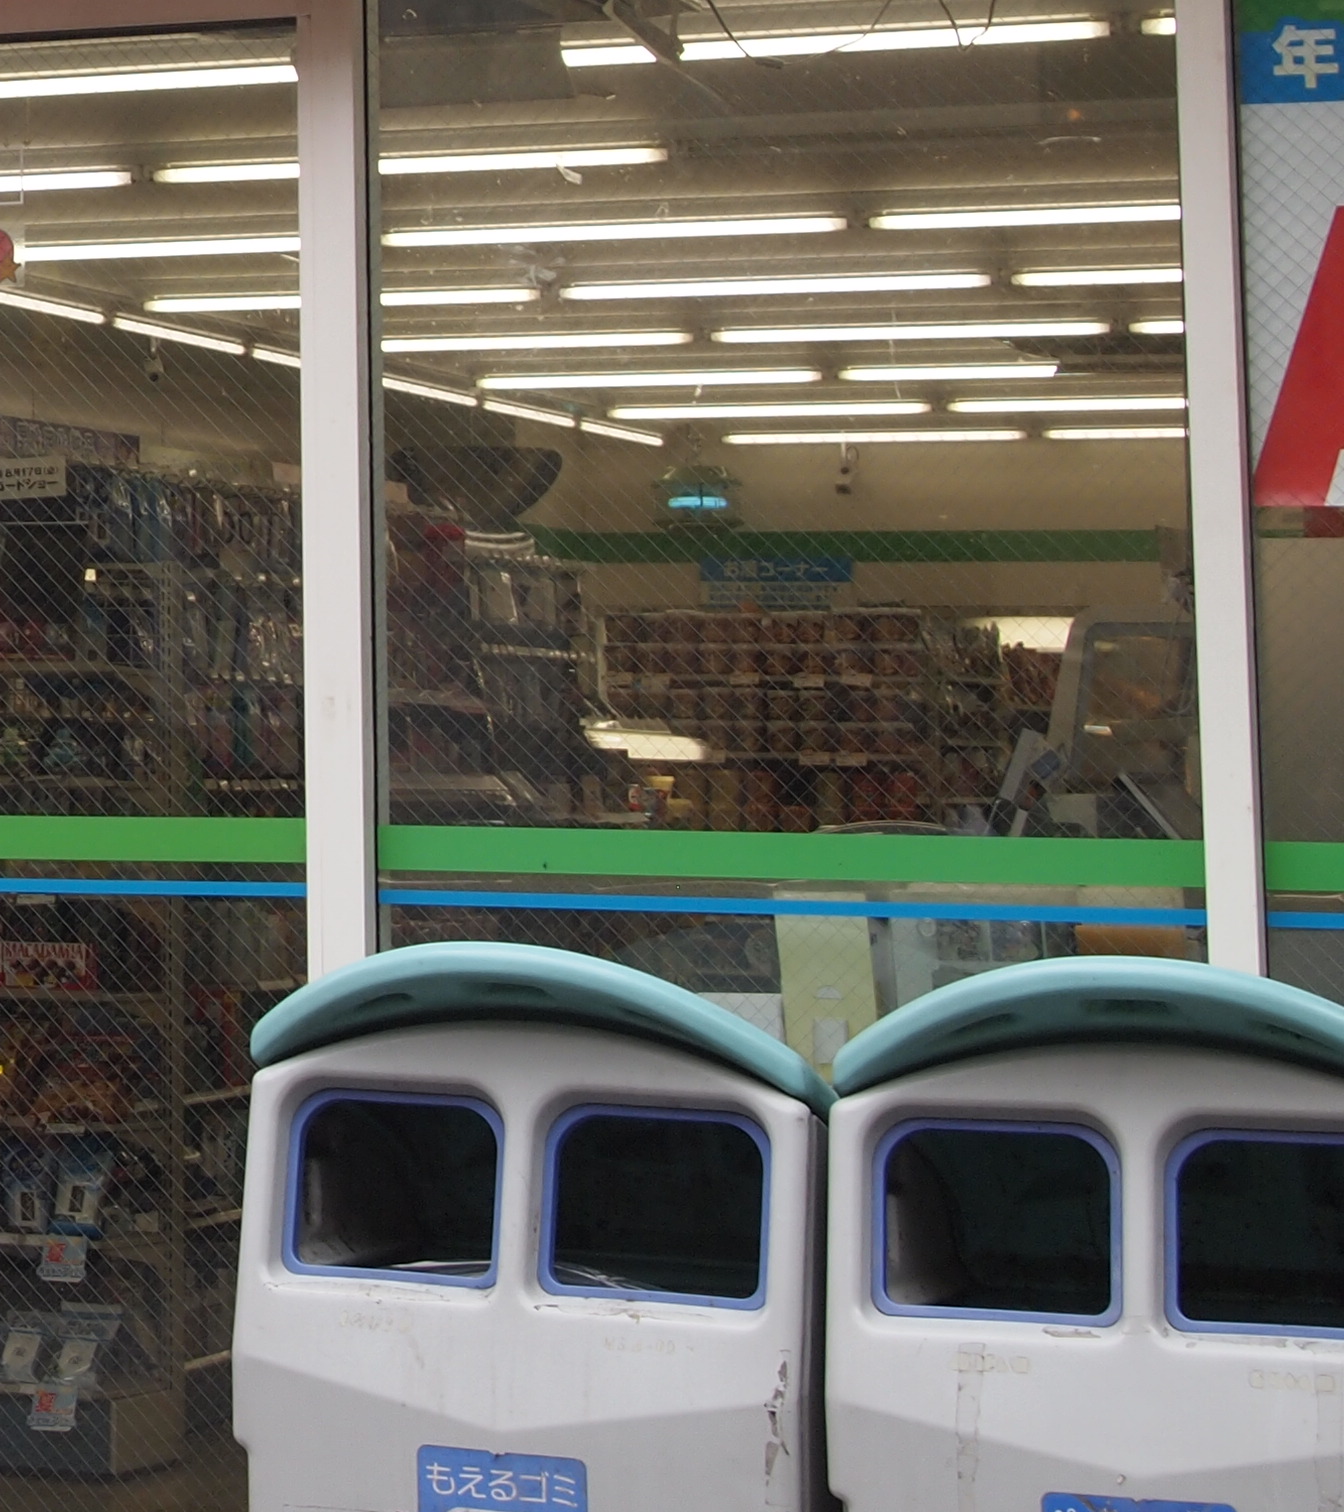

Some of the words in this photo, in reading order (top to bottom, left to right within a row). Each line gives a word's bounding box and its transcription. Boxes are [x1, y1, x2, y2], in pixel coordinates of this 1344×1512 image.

[1272, 25, 1339, 90] 年
[425, 1462, 578, 1508] もえるゴミ
